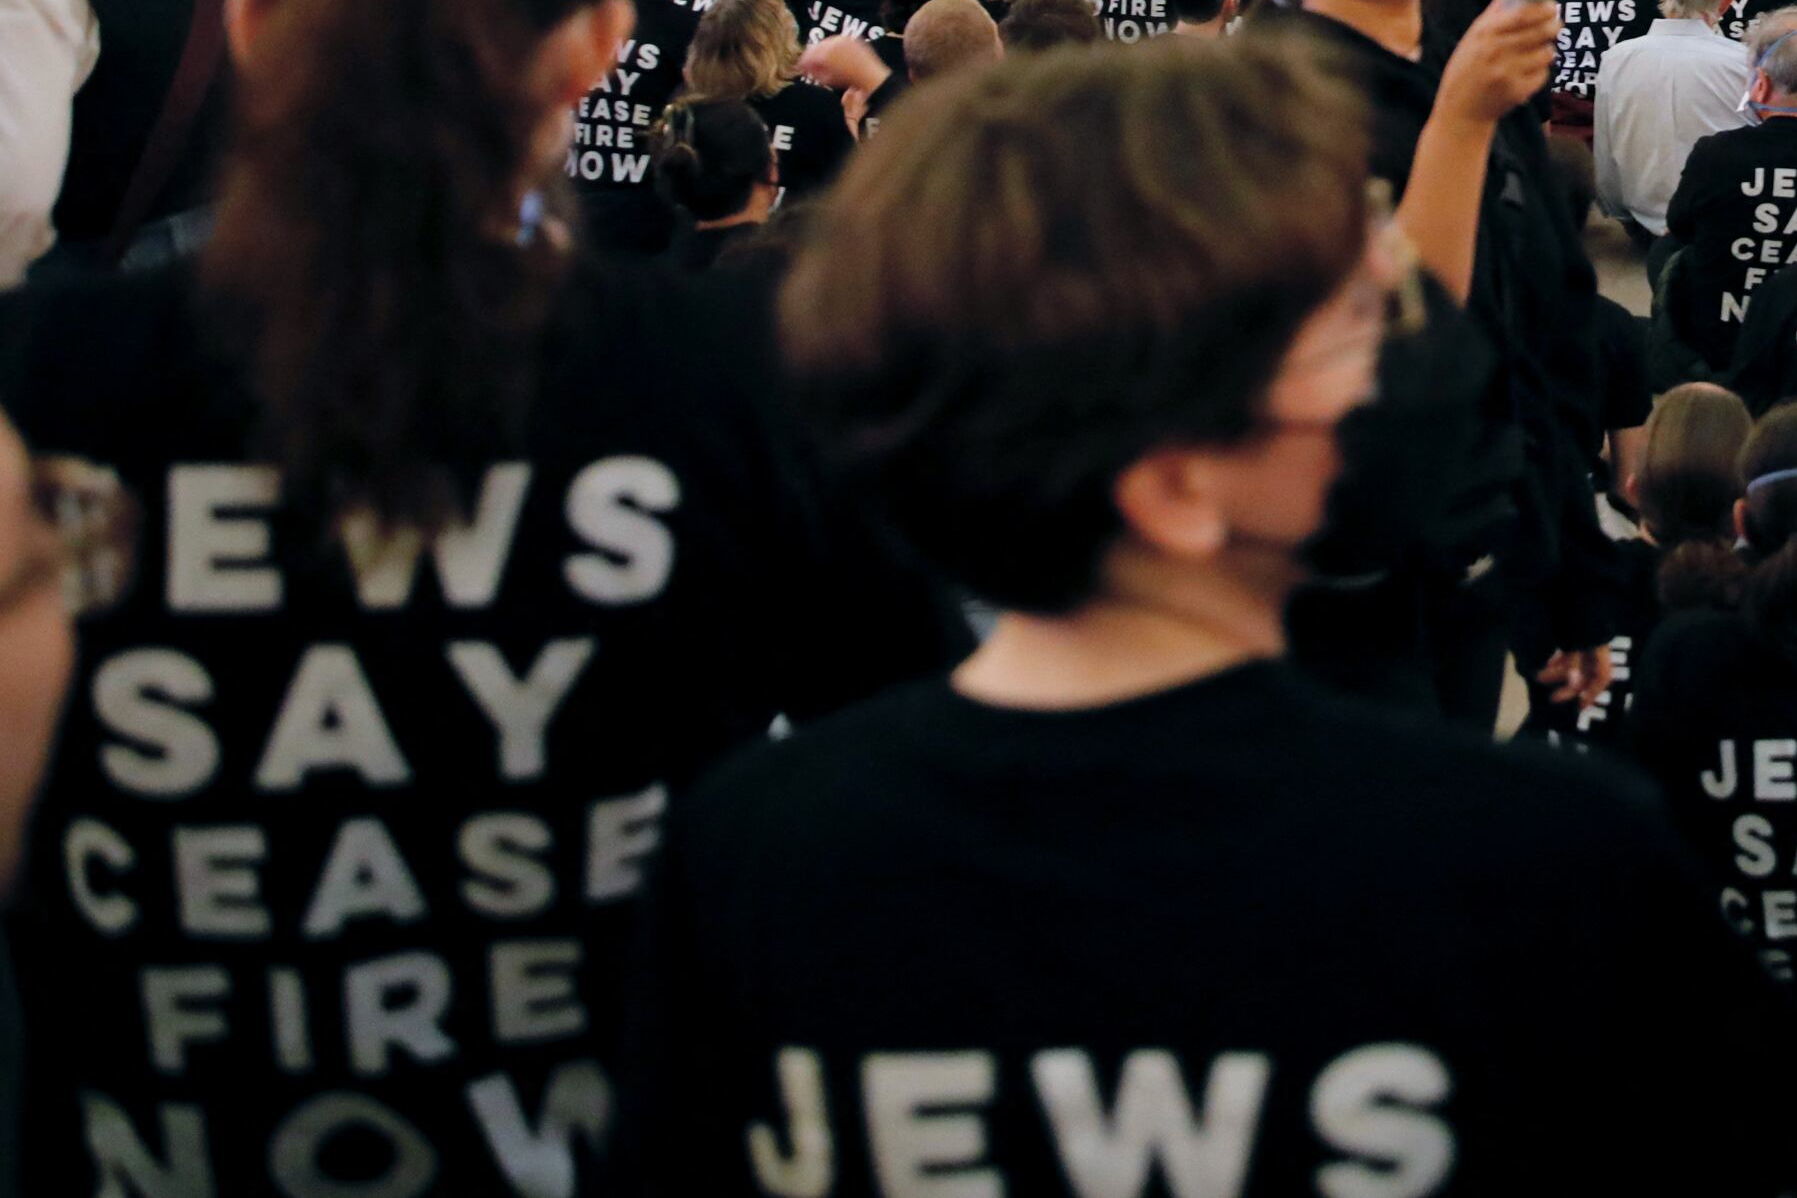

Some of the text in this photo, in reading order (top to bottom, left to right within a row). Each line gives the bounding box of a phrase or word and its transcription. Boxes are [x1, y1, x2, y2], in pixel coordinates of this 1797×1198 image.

[1557, 25, 1624, 51] SAY
[575, 121, 634, 149] FIRE
[579, 96, 652, 127] EASE
[166, 455, 682, 610] EWS
[91, 636, 596, 795] SAY
[65, 785, 669, 935] CEASE
[140, 938, 588, 1076] FIRE
[747, 1041, 1455, 1198] JEWS
